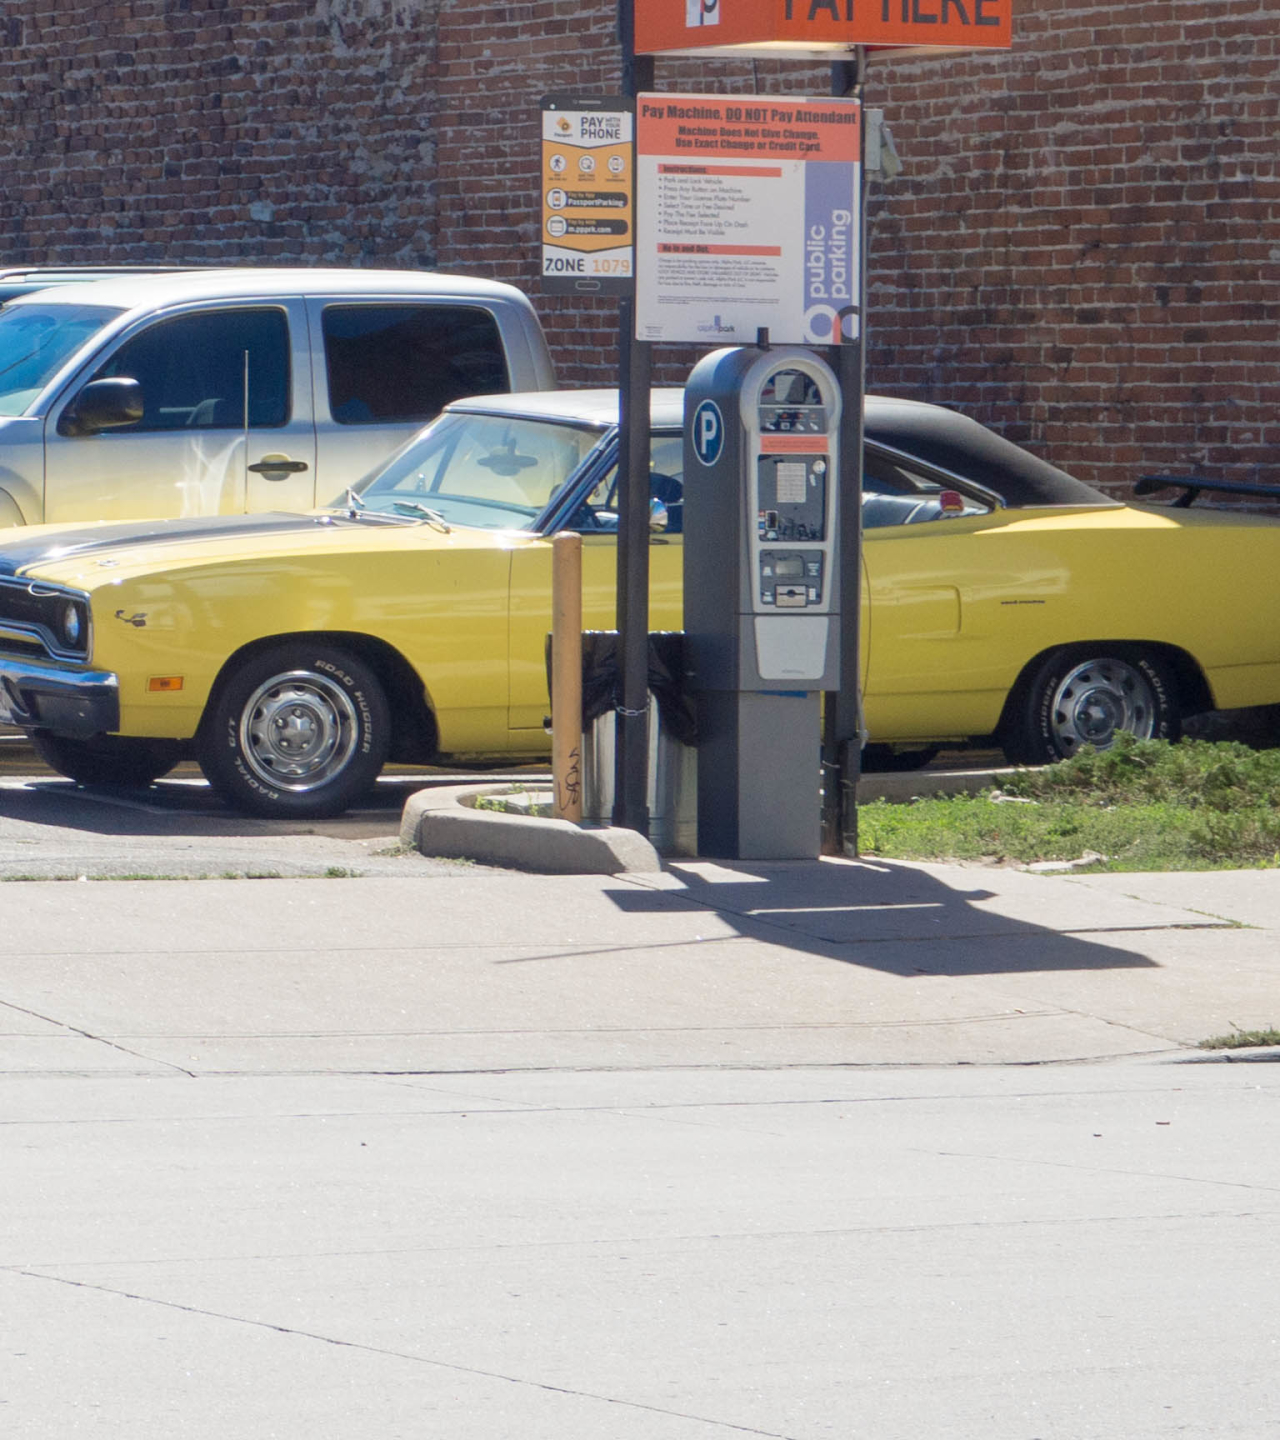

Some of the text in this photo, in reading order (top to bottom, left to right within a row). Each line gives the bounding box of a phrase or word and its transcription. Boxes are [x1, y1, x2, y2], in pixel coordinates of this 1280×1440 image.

[580, 116, 604, 128] PAY
[642, 105, 664, 119] Pay
[726, 107, 742, 121] DO
[745, 107, 768, 122] NOT
[771, 109, 792, 123] Pay
[795, 110, 856, 125] Attendant
[580, 128, 621, 139] PHONE
[678, 125, 819, 141] Machine Does Not Give Change.
[675, 138, 821, 152] Use Exact Change or Credit Card.
[568, 198, 625, 208] PassportParking
[807, 225, 828, 299] public
[828, 209, 851, 299] parking
[592, 259, 630, 273] 1079
[700, 410, 718, 455] P
[1139, 660, 1168, 711] RADIAL
[314, 659, 372, 754] ROAD HUGGER
[234, 755, 280, 800] RADIAL
